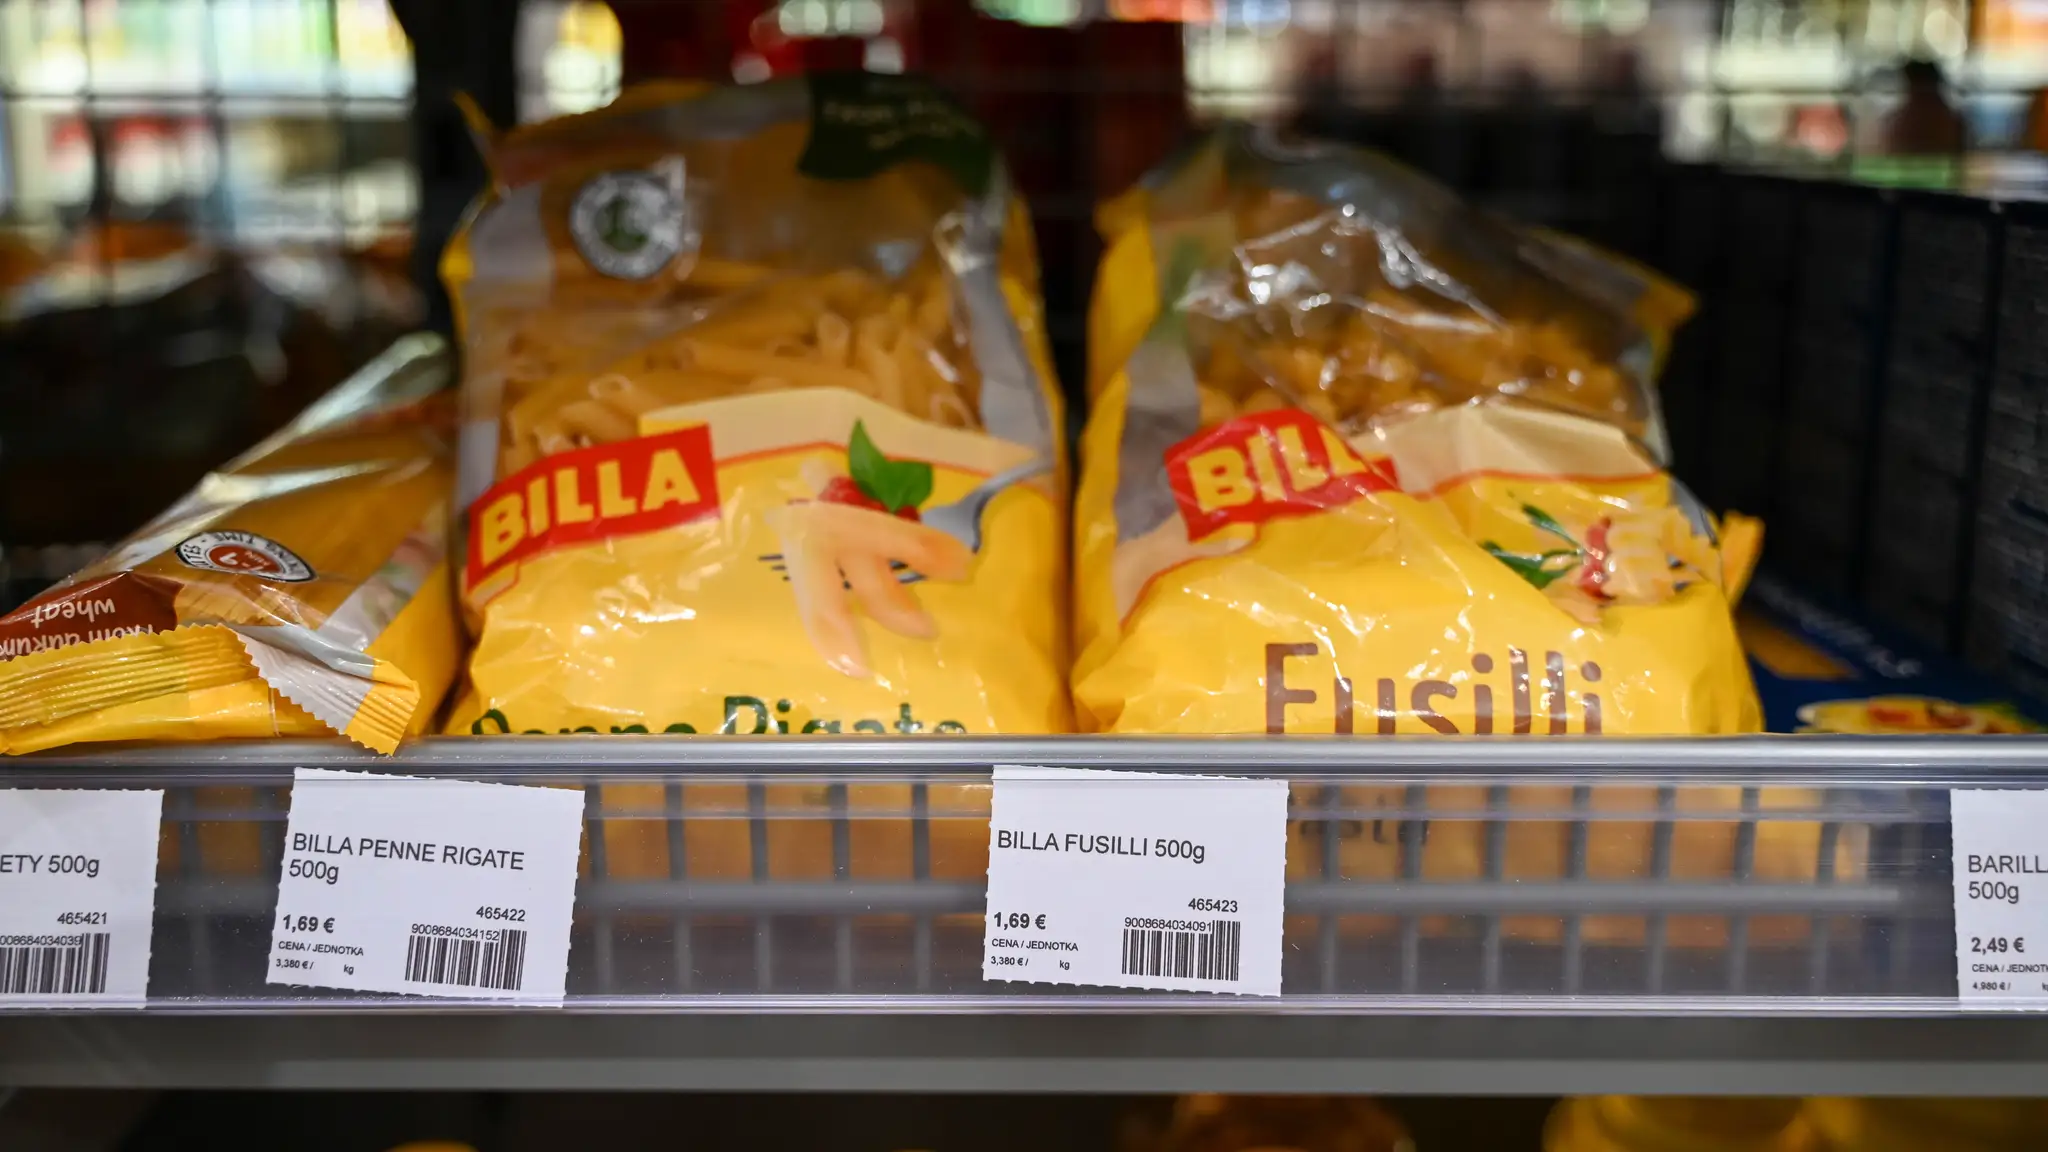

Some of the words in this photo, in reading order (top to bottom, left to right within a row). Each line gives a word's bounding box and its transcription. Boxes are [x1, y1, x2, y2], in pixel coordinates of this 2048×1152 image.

[479, 448, 700, 567] BILLA
[30, 598, 116, 629] wheat
[1265, 642, 1602, 735] Fusilli
[293, 832, 353, 856] BILLA
[358, 838, 436, 862] PENNE
[442, 845, 525, 871] RIGATE
[997, 830, 1059, 851] BILLA
[1065, 834, 1148, 856] FUSILLI
[1154, 838, 1205, 864] 500g
[48, 854, 99, 878] 500g
[289, 858, 339, 885] 500g
[1968, 854, 2048, 874] BARILL
[1968, 881, 2019, 904] 500g
[476, 906, 526, 922] 465422
[1188, 898, 1238, 913] 465423
[57, 912, 108, 925] 465421
[282, 914, 319, 933] 1,69
[323, 917, 335, 933] €
[993, 911, 1030, 930] 1,69
[1035, 913, 1047, 930] €
[1124, 916, 1212, 932] 9008684034091
[411, 923, 500, 941] 9008684034152
[278, 940, 306, 951] CENA
[312, 944, 364, 956] JEDNOTKA
[991, 938, 1019, 948] CENA
[1026, 940, 1079, 951] JEDNOTKA
[1971, 937, 2008, 955] 2,49
[2013, 937, 2025, 953] €
[276, 958, 300, 969] 3,380
[302, 960, 308, 969] €
[343, 964, 354, 976] kg
[990, 955, 1015, 966] 3,380
[1017, 957, 1024, 966] €
[1059, 960, 1070, 971] kg
[1971, 963, 2000, 973] CENA
